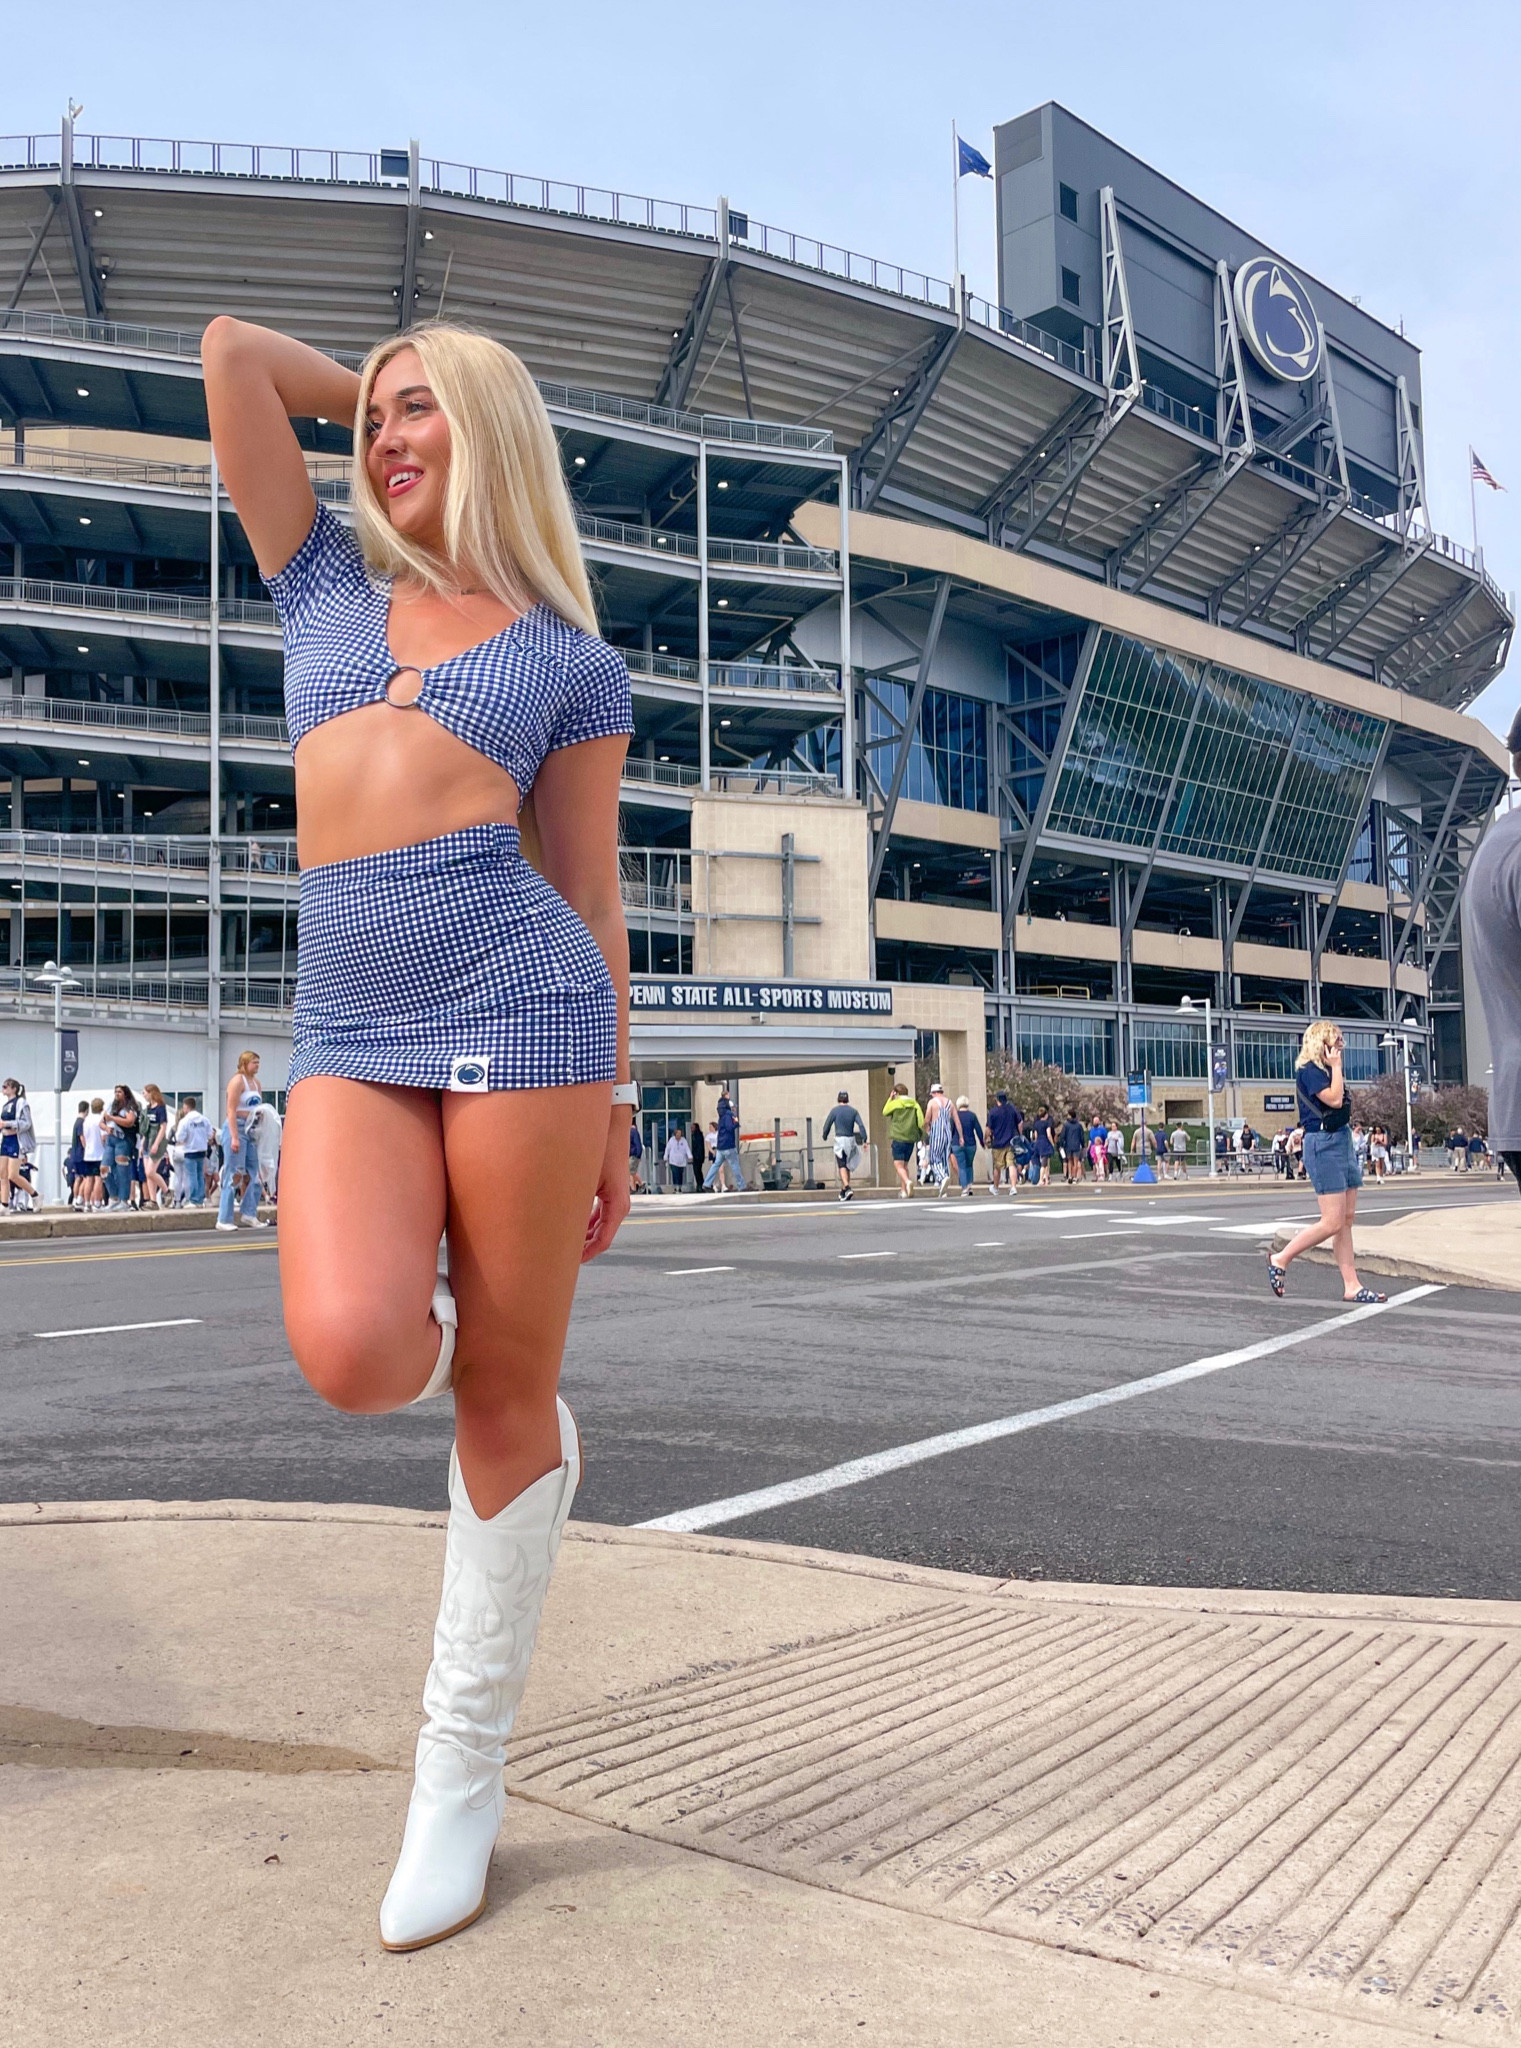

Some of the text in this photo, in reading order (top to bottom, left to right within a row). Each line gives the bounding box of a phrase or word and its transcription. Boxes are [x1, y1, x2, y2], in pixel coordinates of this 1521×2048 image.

[505, 637, 565, 675] State
[671, 985, 718, 1006] STATE
[723, 987, 823, 1008] ALL-SPORTS
[827, 990, 891, 1011] MUSEUM
